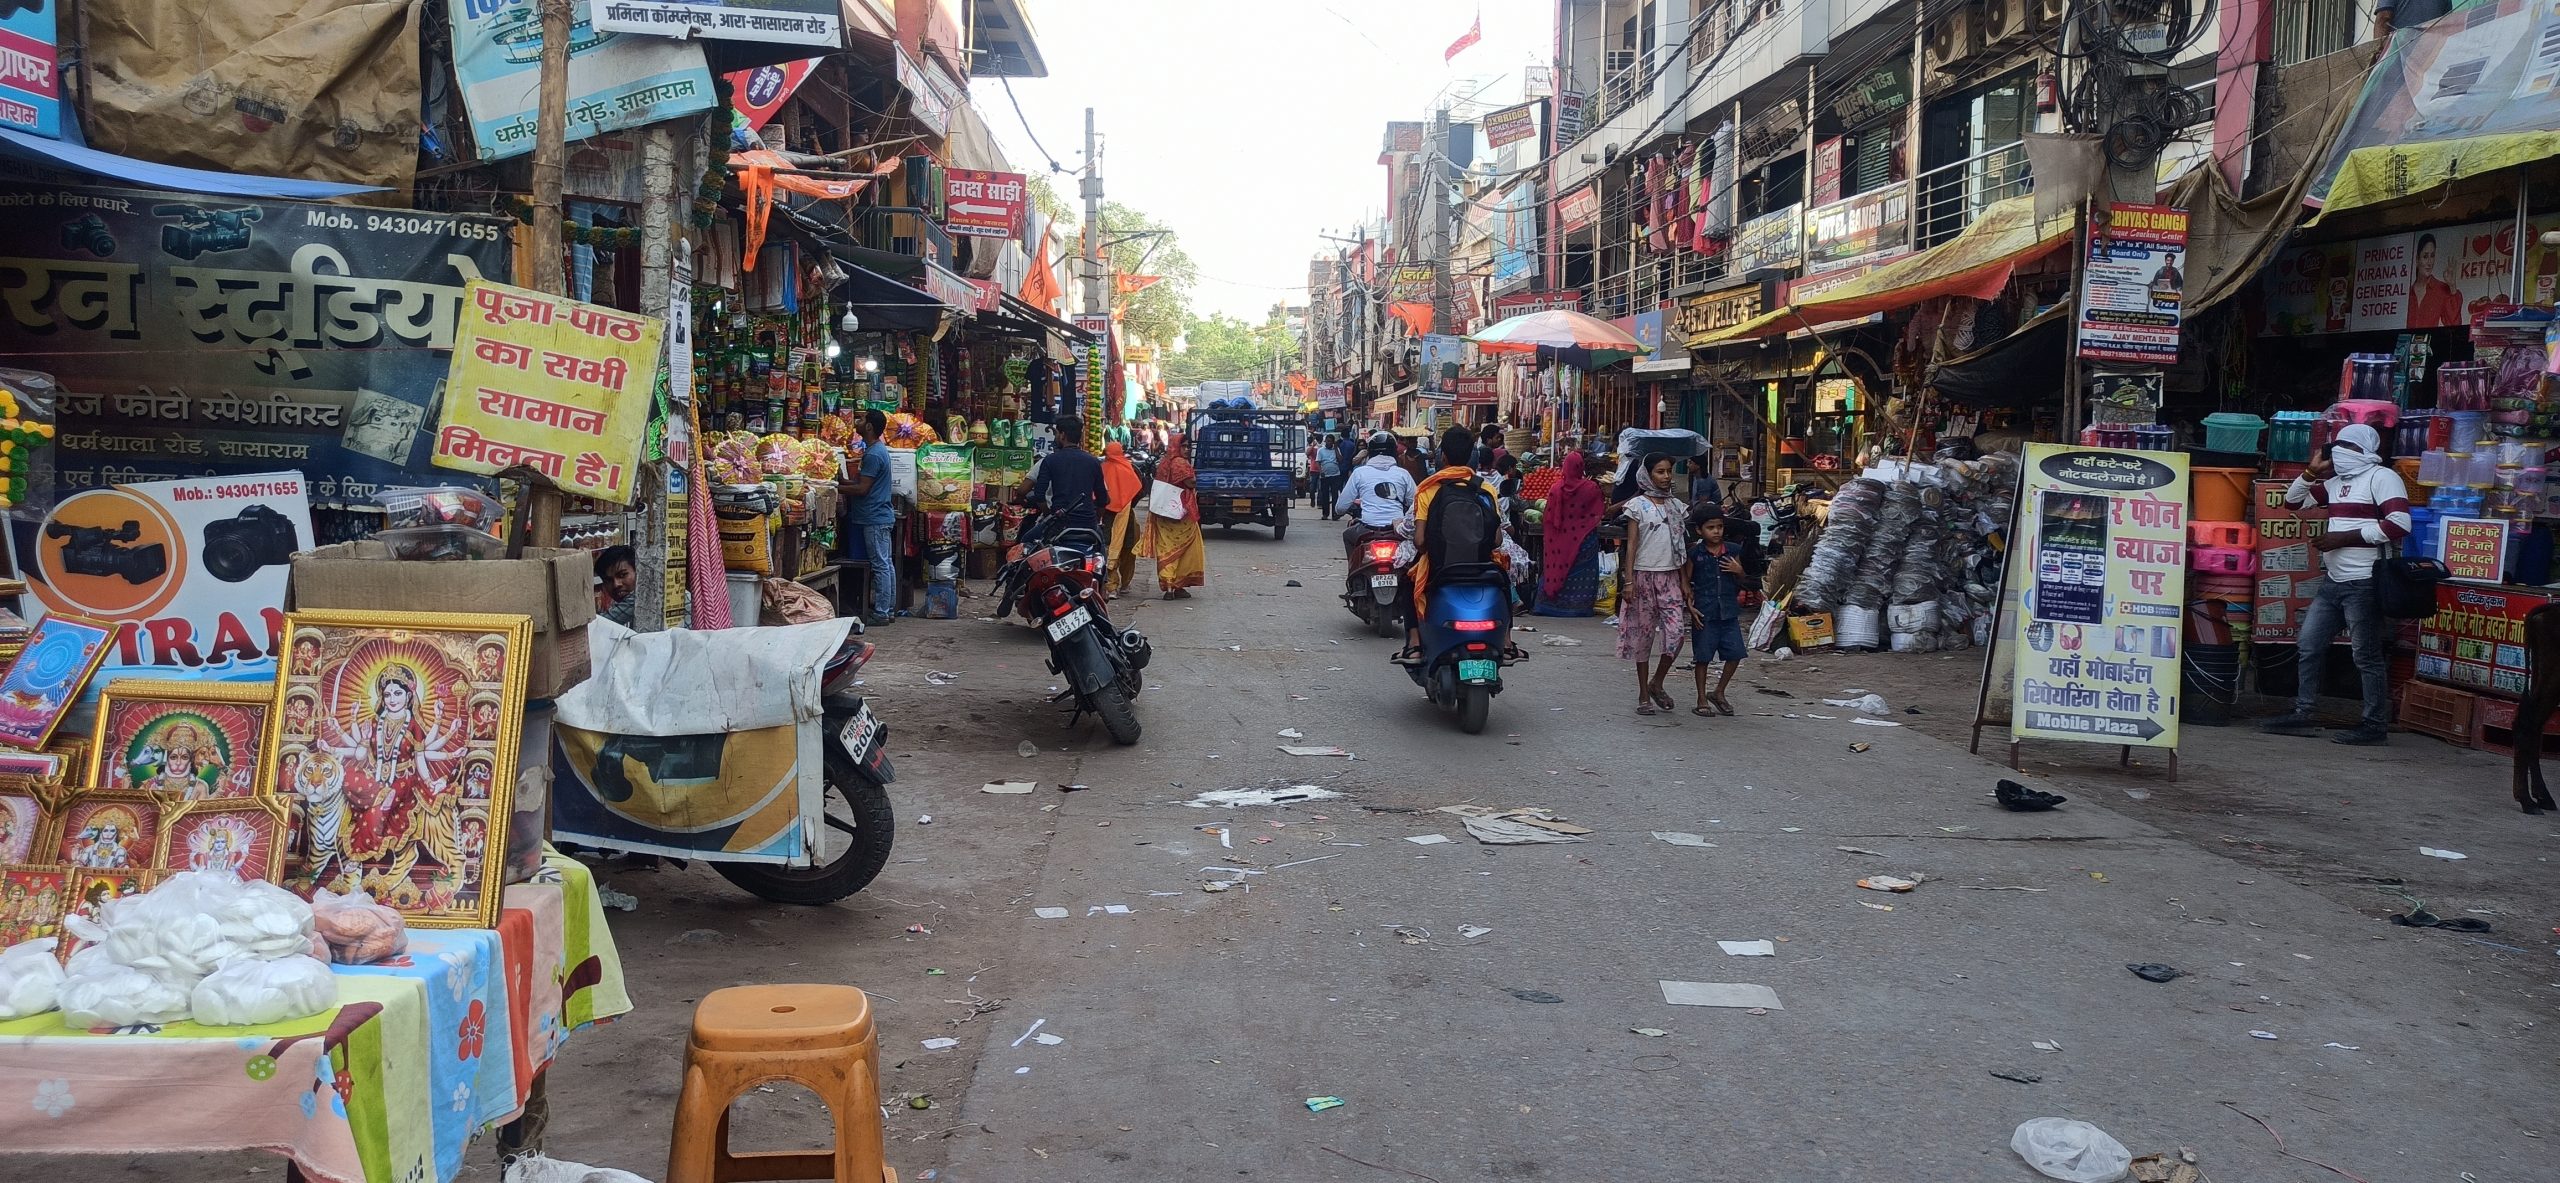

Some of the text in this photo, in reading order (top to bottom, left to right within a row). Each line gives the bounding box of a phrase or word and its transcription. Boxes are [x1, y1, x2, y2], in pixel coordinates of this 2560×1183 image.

[606, 3, 826, 35] प्रमिला कॉम्प्लेक्स, आरा-सासाराम रोड
[495, 80, 696, 145] धर्मशा रोड, सासाराम
[1488, 109, 1529, 125] OXBRIDGE
[60, 191, 88, 207] लिए
[986, 181, 1022, 206] साड़ी
[306, 209, 499, 242] Mob. 9430471655
[1849, 202, 1882, 235] GANGA
[2151, 213, 2187, 232] GANGA
[2130, 229, 2160, 240] Coaching
[2162, 231, 2183, 241] Center
[2093, 248, 2147, 258] Bir Board Only
[2364, 246, 2404, 264] PRINCE
[2357, 263, 2408, 281] KIRANA &
[2461, 258, 2529, 280] KETCHU
[2355, 283, 2407, 299] GENERAL
[473, 286, 645, 344] पूजा-पाठ
[1699, 296, 1750, 332] JEWELLERS
[2155, 300, 2176, 308] Free
[2361, 302, 2397, 317] STORE
[2132, 334, 2157, 342] MEHTA
[474, 336, 628, 392] का सभी
[55, 385, 344, 428] रेज फोटो स्पेशलिस्ट
[477, 387, 608, 437] सामान
[62, 430, 310, 461] धर्मशाला रोड, सासाराम
[437, 425, 566, 478] मिलता
[573, 450, 621, 491] है।
[2073, 456, 2142, 471] यहाँ कटे-फटे
[64, 467, 95, 489] एवं
[319, 475, 337, 498] के
[341, 476, 378, 502] लिए
[1216, 477, 1275, 488] BAXY
[2059, 468, 2080, 479] नोट
[2081, 470, 2109, 483] बदले
[2109, 473, 2135, 484] जाते
[173, 481, 299, 501] Mob.: 9430471655
[2130, 492, 2183, 530] फोन
[2260, 513, 2329, 538] बदले जा
[2467, 526, 2500, 538] कटे-फटे
[2114, 536, 2184, 565] ब्याज
[2451, 540, 2494, 551] गले-जले
[2449, 552, 2495, 565] नोट बदले
[2129, 569, 2166, 596] पर
[2453, 566, 2474, 577] जाते
[1055, 607, 1085, 630] BR 24
[2132, 604, 2155, 613] HDB
[2256, 627, 2283, 637] Mob:
[2439, 603, 2452, 631] कटे
[2454, 605, 2468, 635] फटे
[2469, 607, 2485, 637] नोट
[2486, 611, 2508, 641] बदले
[103, 608, 285, 669] IRA
[2049, 653, 2153, 684] यहाँ मोबाईल
[2023, 678, 2101, 709] रिपेयरिंग
[2106, 687, 2141, 713] होता
[2146, 687, 2160, 714] है
[853, 720, 866, 741] PRESS
[853, 710, 877, 758] 8001
[2037, 712, 2139, 735] Mobile Plaza
